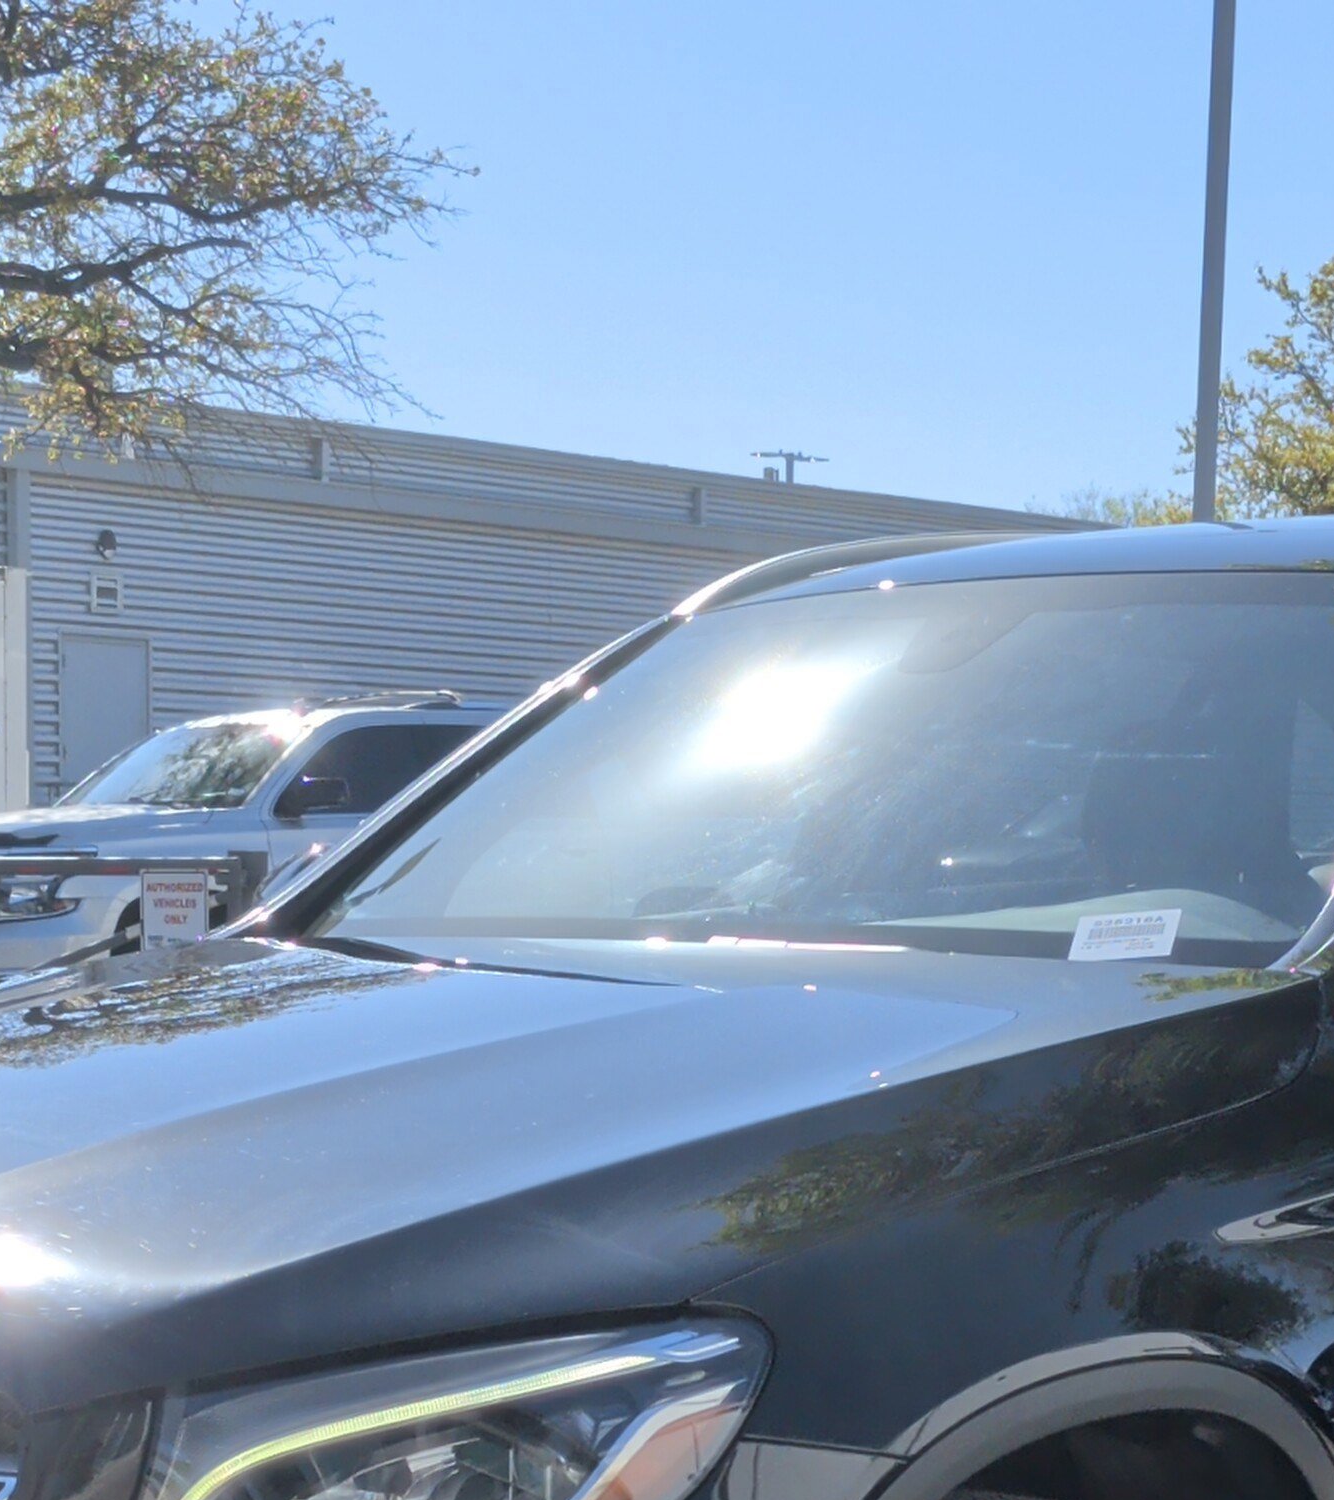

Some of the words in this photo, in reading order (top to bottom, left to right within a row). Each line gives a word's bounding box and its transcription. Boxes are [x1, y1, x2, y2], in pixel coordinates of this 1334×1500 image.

[146, 882, 204, 893] AUTHORIZED
[152, 898, 197, 909] VEHICLES
[163, 914, 188, 925] ONLY
